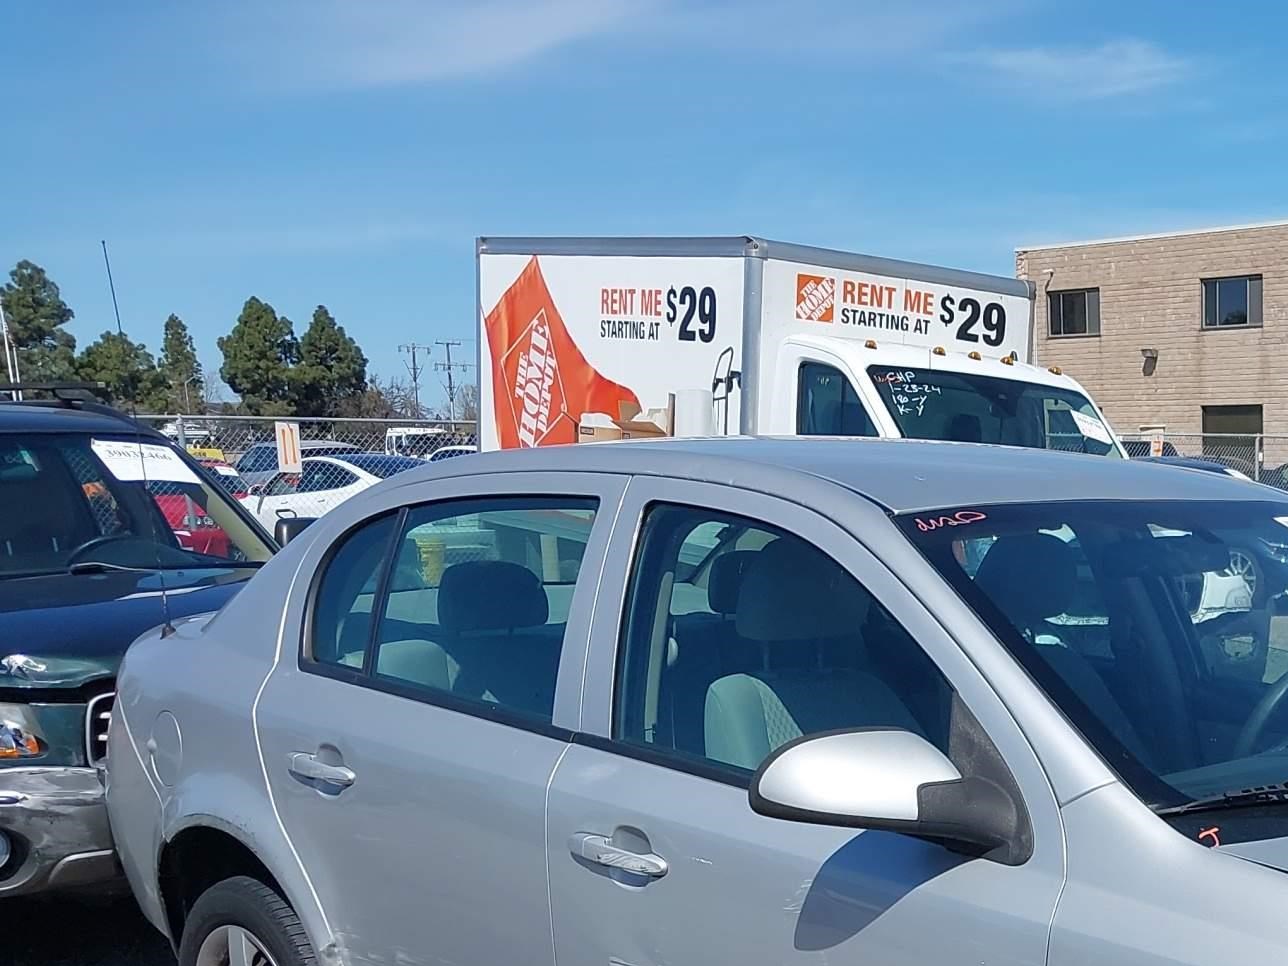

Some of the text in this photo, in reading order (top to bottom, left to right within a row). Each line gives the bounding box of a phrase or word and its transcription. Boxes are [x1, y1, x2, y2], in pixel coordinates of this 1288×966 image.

[601, 288, 662, 317] RENT ME
[796, 277, 836, 319] HOME
[801, 280, 817, 298] THE
[811, 296, 835, 321] DEPOT
[843, 280, 935, 316] RENT ME
[600, 319, 661, 341] STARTING AT
[666, 284, 717, 343] $29
[841, 307, 931, 336] STARTING AT
[939, 294, 1007, 347] $29
[514, 351, 529, 399] THE
[519, 319, 550, 449] HOME
[536, 350, 557, 433] DEPOT
